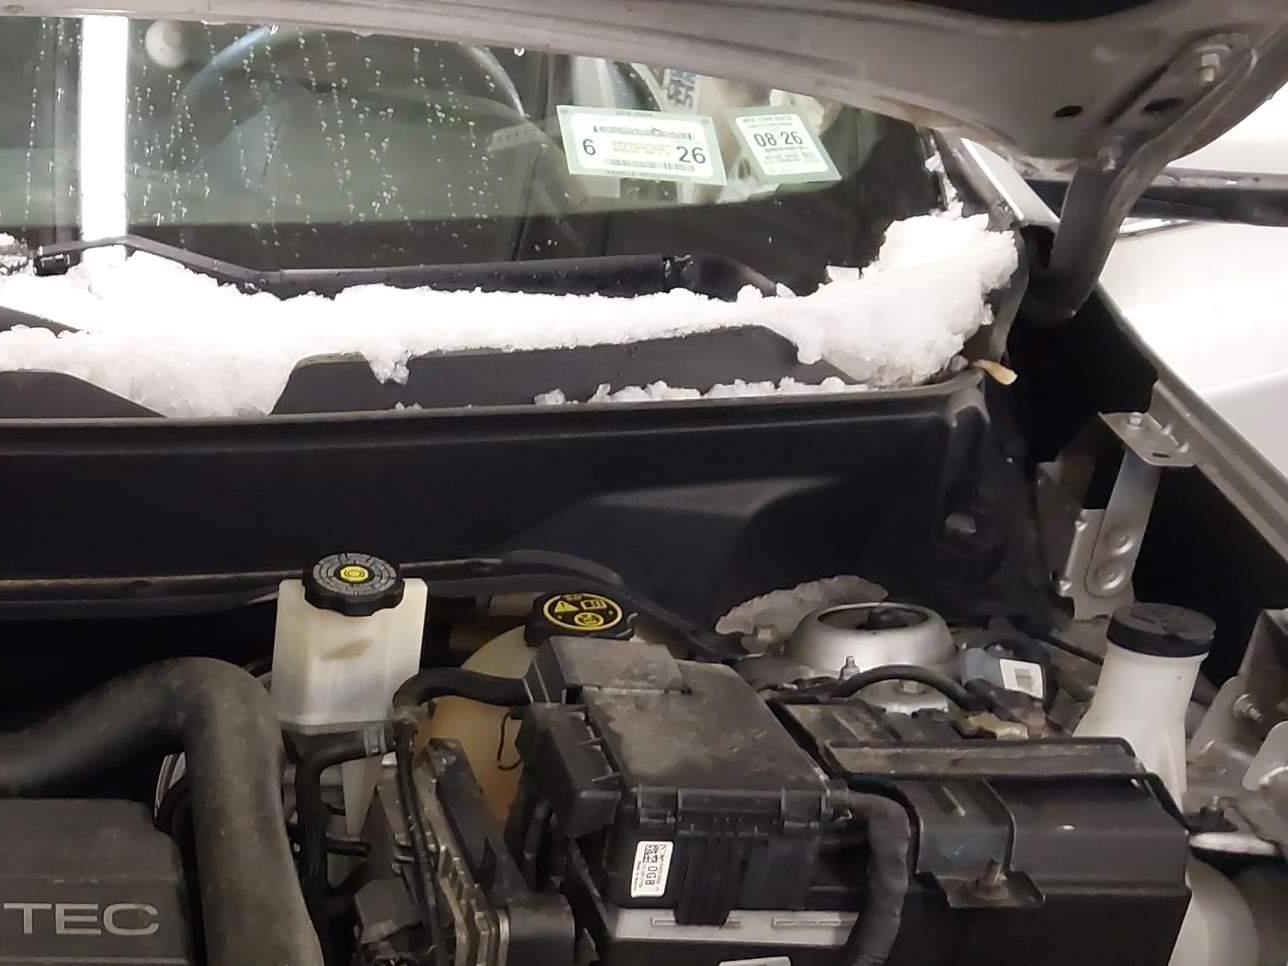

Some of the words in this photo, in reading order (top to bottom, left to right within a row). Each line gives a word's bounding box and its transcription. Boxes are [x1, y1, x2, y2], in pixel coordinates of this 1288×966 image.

[582, 138, 597, 156] 6
[753, 132, 777, 147] 08
[780, 131, 803, 145] 26
[676, 146, 706, 165] 26
